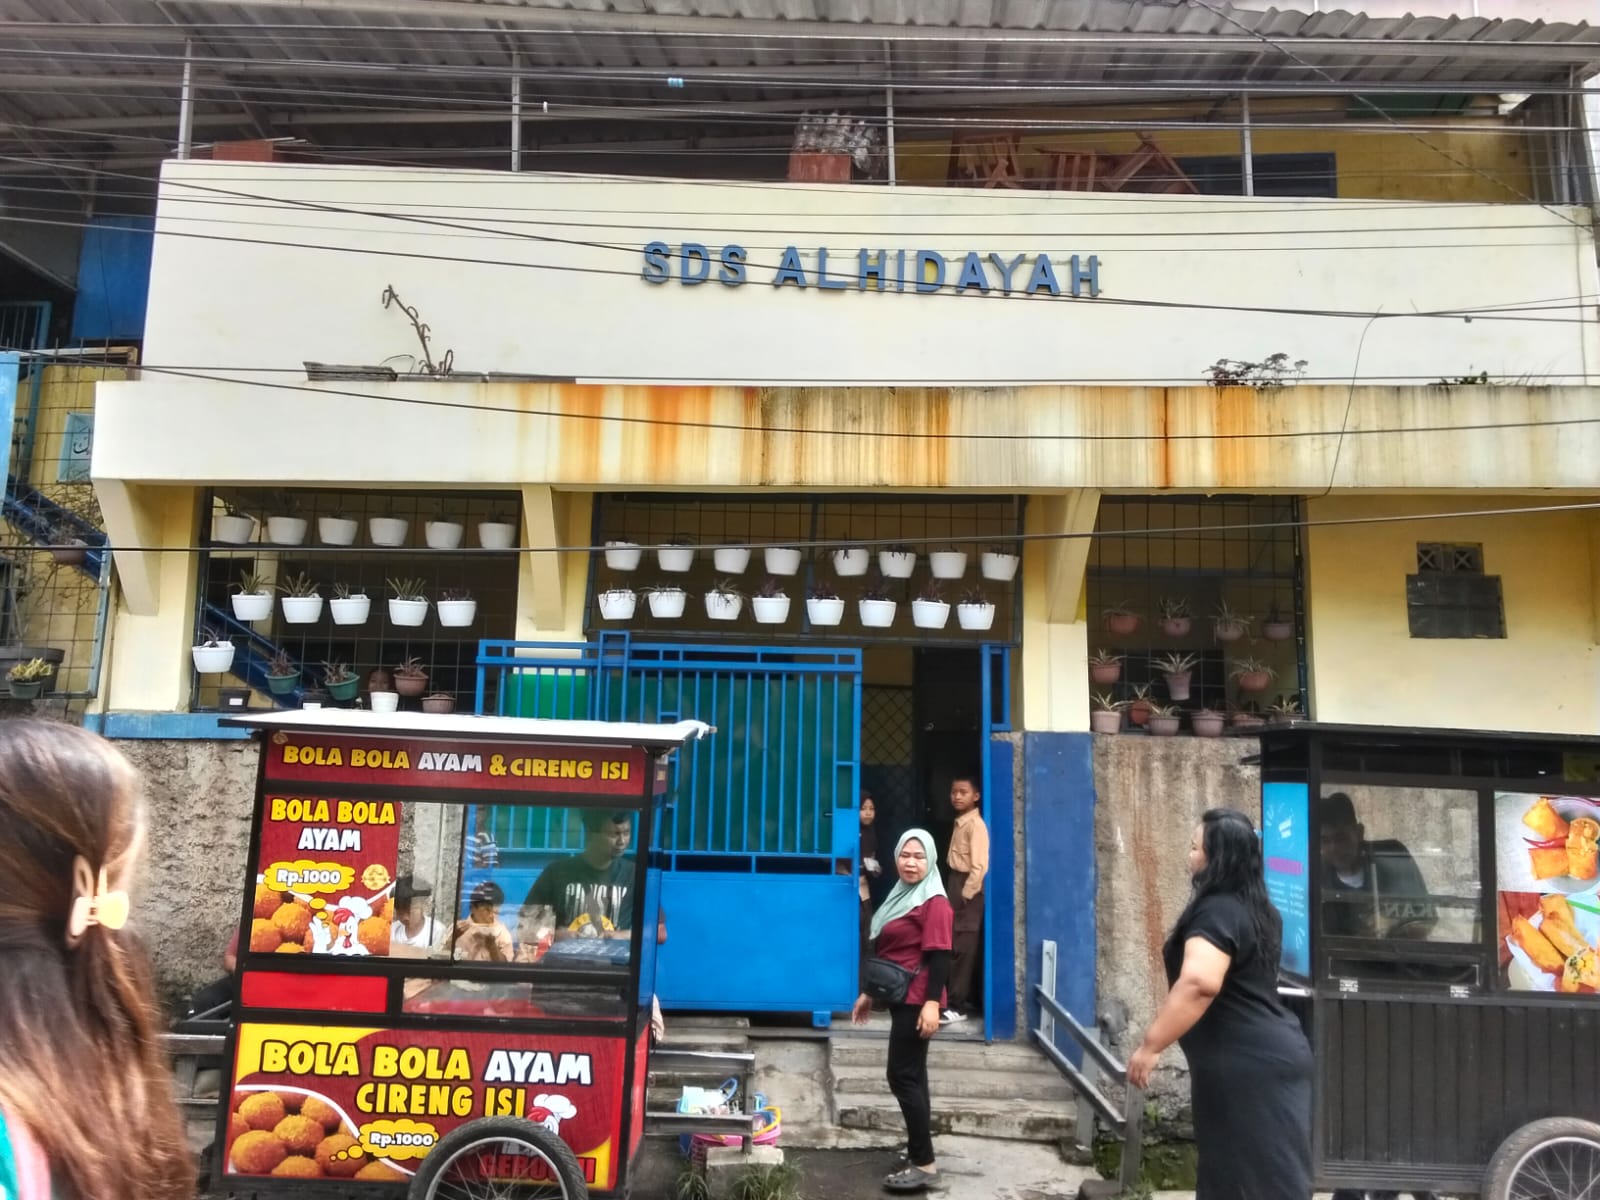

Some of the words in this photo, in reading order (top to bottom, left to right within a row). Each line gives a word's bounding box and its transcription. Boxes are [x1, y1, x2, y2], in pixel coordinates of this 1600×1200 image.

[642, 241, 748, 287] SDS
[282, 745, 343, 766] BOLA
[350, 749, 411, 770] BOLA
[417, 752, 484, 773] AYAM
[600, 761, 630, 781] ISI
[270, 798, 331, 823] BOLA
[336, 800, 397, 826] BOLA
[297, 827, 363, 852] AYAM
[276, 868, 342, 887] Rp.1000
[261, 1040, 361, 1076] BOLA
[372, 1045, 473, 1081] BOLA
[483, 1048, 593, 1086] AYAM
[355, 1082, 474, 1118] CIRENG
[484, 1086, 527, 1118] ISI
[370, 1131, 434, 1148] Rp.1000
